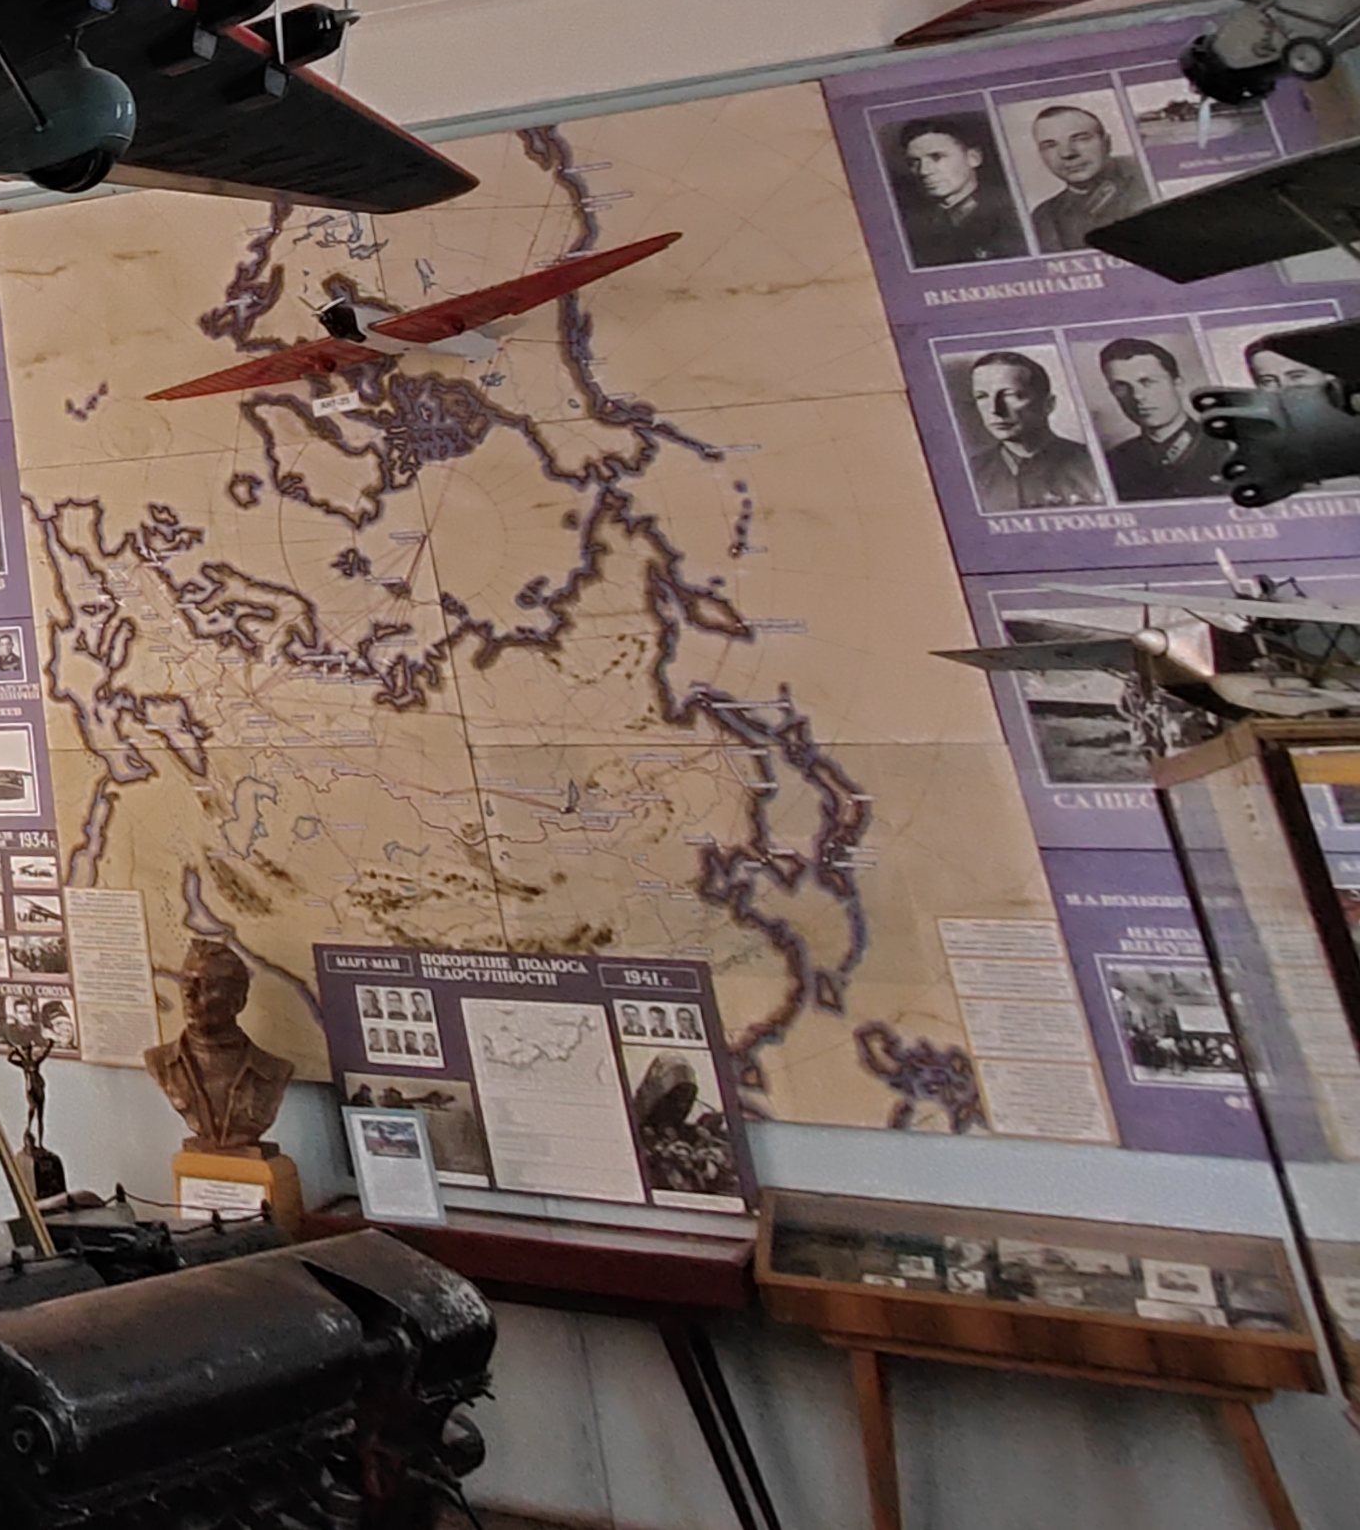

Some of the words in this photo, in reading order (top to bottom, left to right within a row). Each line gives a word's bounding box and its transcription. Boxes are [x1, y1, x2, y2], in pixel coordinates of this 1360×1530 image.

[1045, 254, 1135, 275] М.Х.ГО
[1228, 496, 1360, 522] С.А.ДАНИЛ
[988, 512, 1137, 535] М.М.ГРОМОВ
[19, 831, 49, 848] 1934
[517, 957, 588, 974] ПОЛЮСА
[421, 966, 558, 986] НЕДОСТУПНОСТИ
[623, 969, 660, 987] 1941
